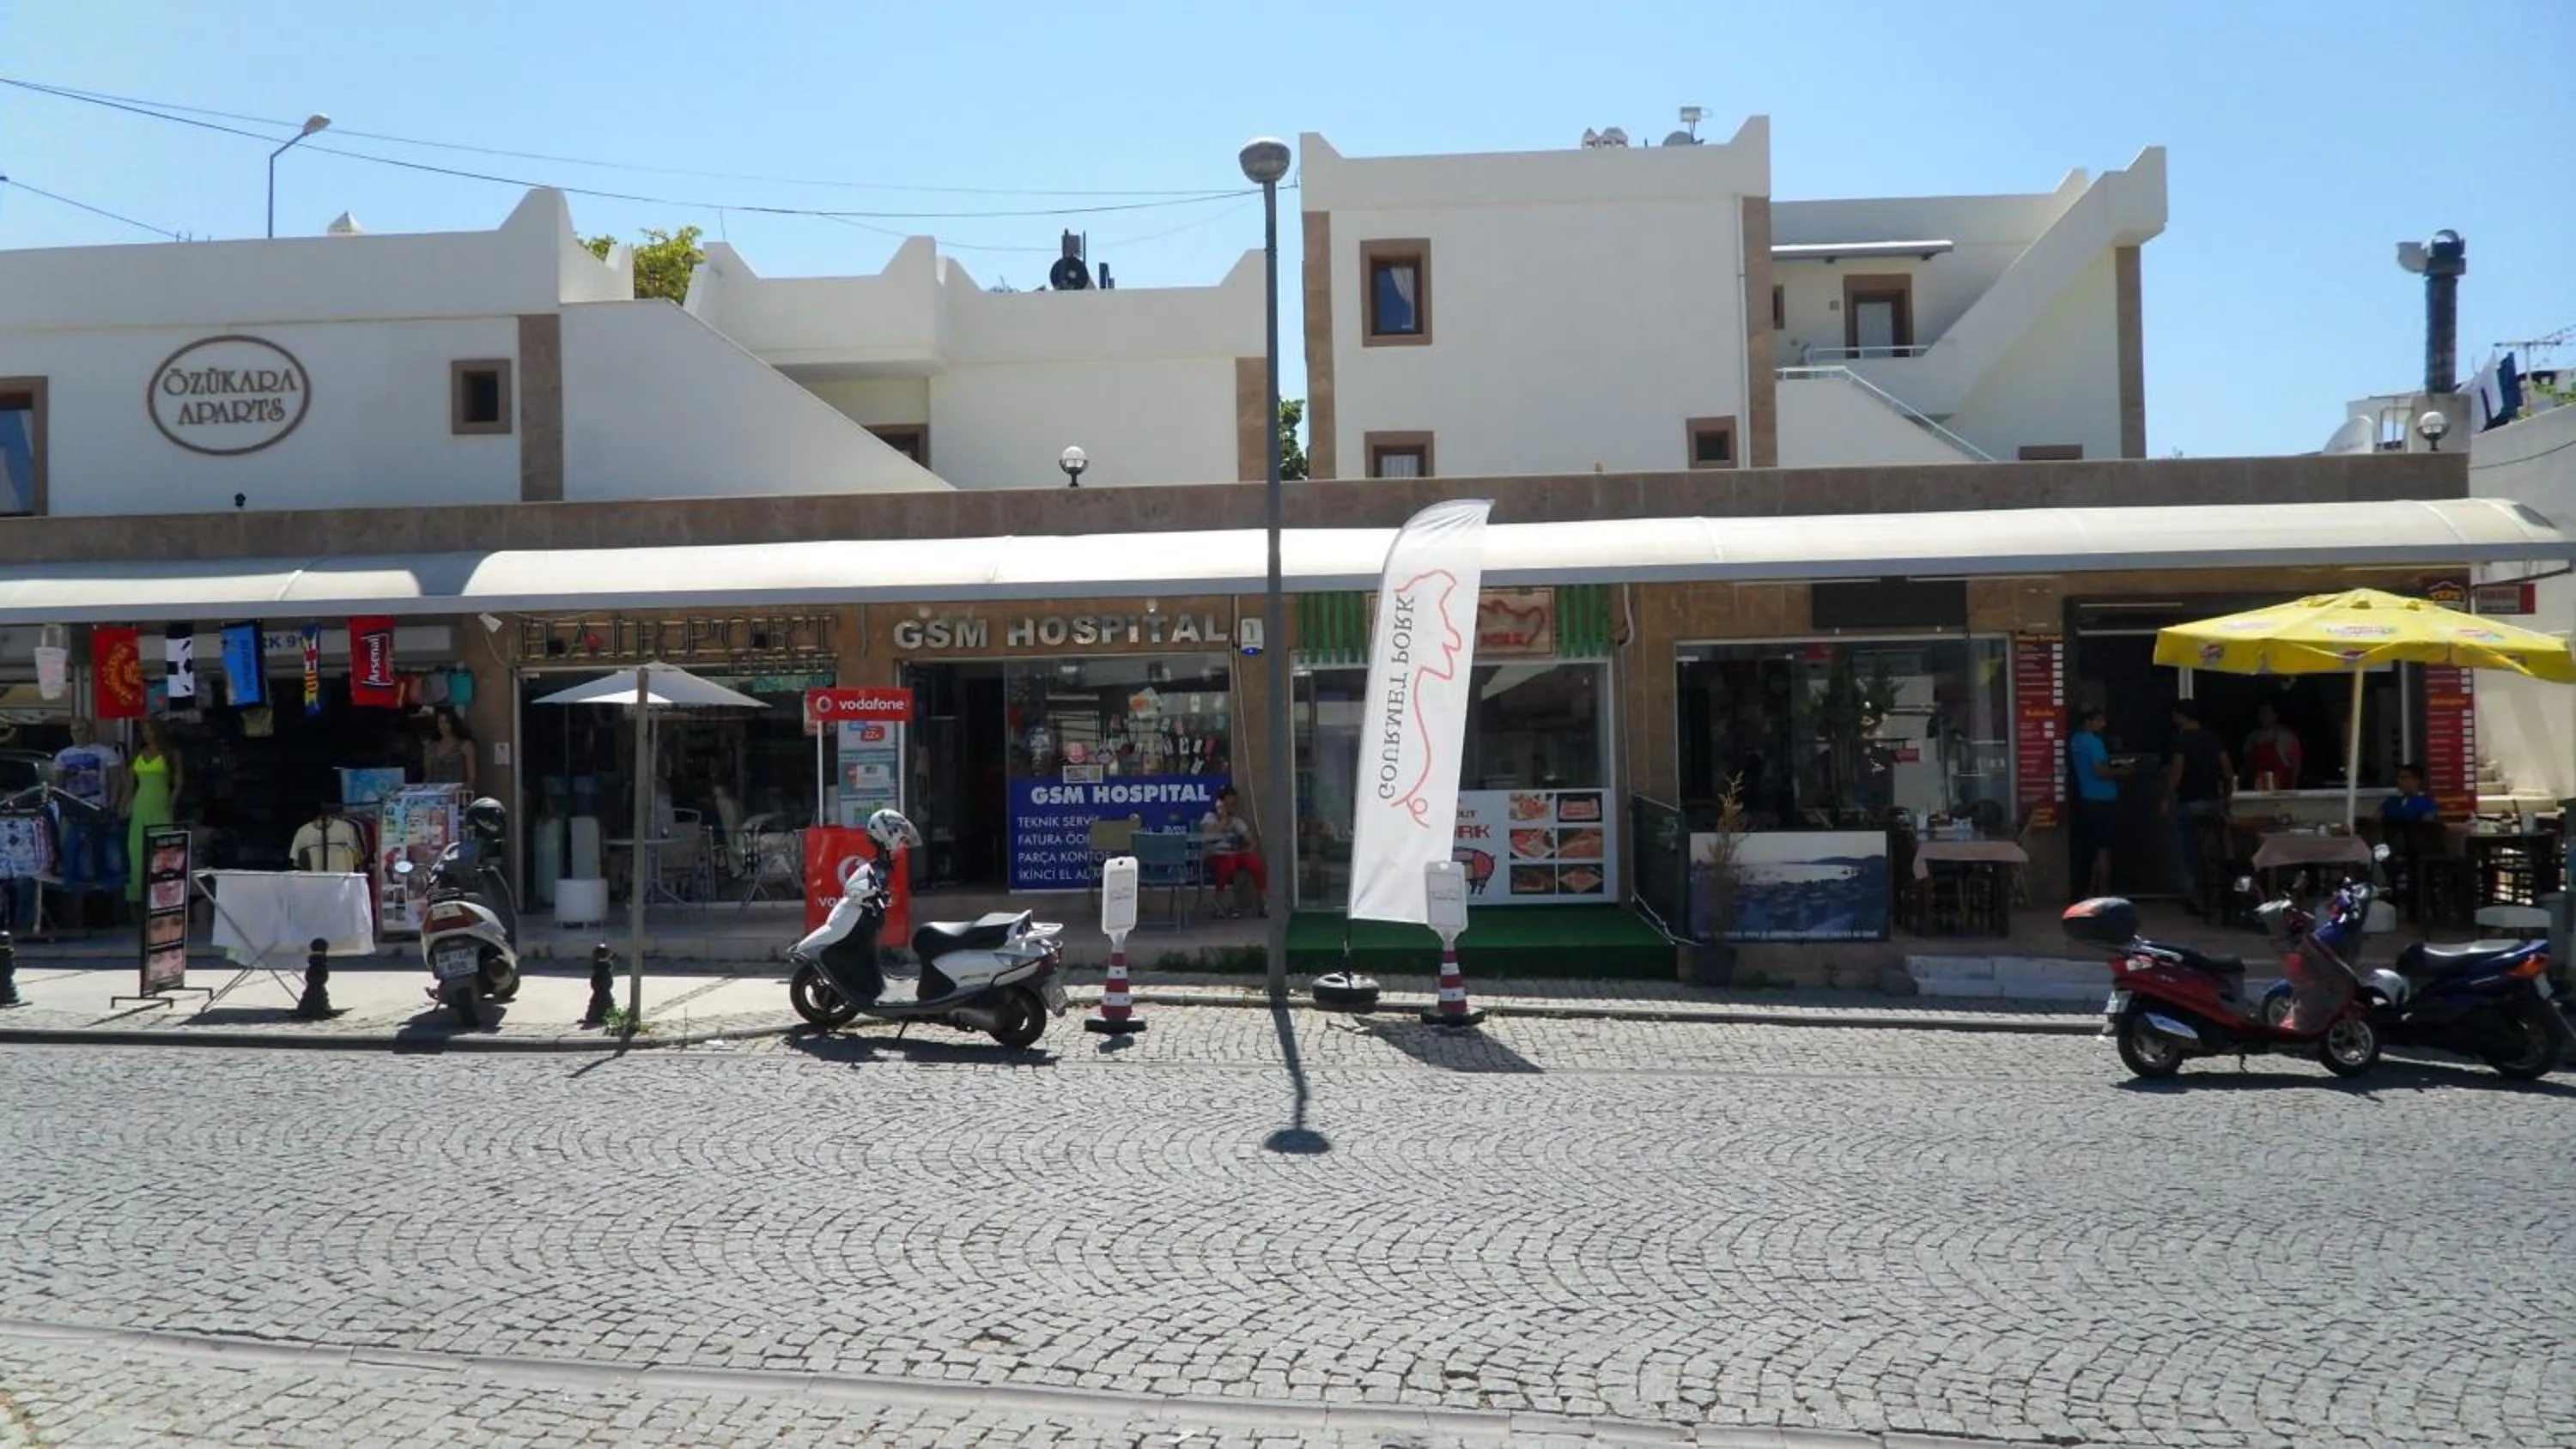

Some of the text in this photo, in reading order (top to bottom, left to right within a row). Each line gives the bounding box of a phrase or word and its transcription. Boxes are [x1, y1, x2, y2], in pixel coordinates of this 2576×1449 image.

[178, 397, 286, 425] APARTS
[893, 614, 1228, 650] GSM HOSPITAL
[367, 634, 380, 683] Arsenal
[838, 697, 905, 711] vodafone
[1031, 784, 1212, 805] GSM HOSPITAL
[1018, 833, 1062, 846] FATURA
[1455, 823, 1491, 839] RK
[1060, 869, 1072, 881] EL
